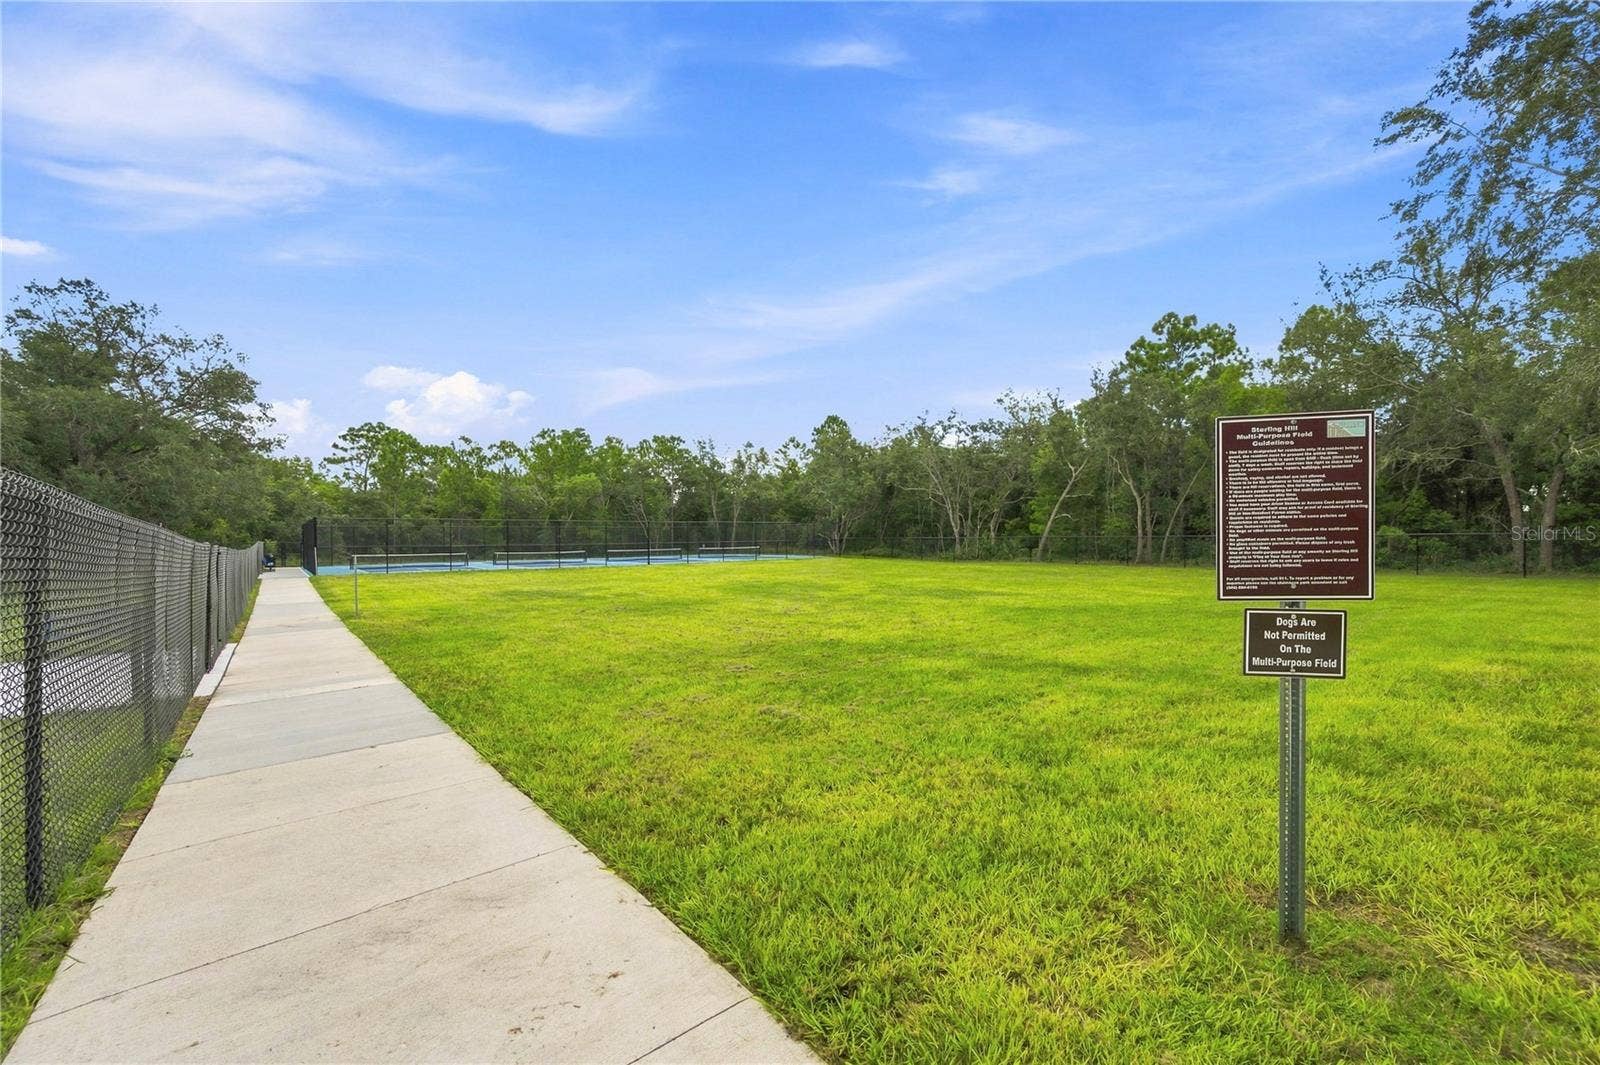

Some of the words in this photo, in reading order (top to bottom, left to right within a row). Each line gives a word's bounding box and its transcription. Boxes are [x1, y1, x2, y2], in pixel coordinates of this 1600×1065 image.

[1276, 618, 1298, 628] Dogs
[1300, 618, 1316, 626] Are
[1264, 630, 1280, 639] Not
[1282, 630, 1326, 640] Permitted
[1280, 645, 1292, 653] On
[1294, 645, 1312, 654] The
[1252, 657, 1312, 668] Multi-Purpose
[1315, 658, 1337, 668] Field
